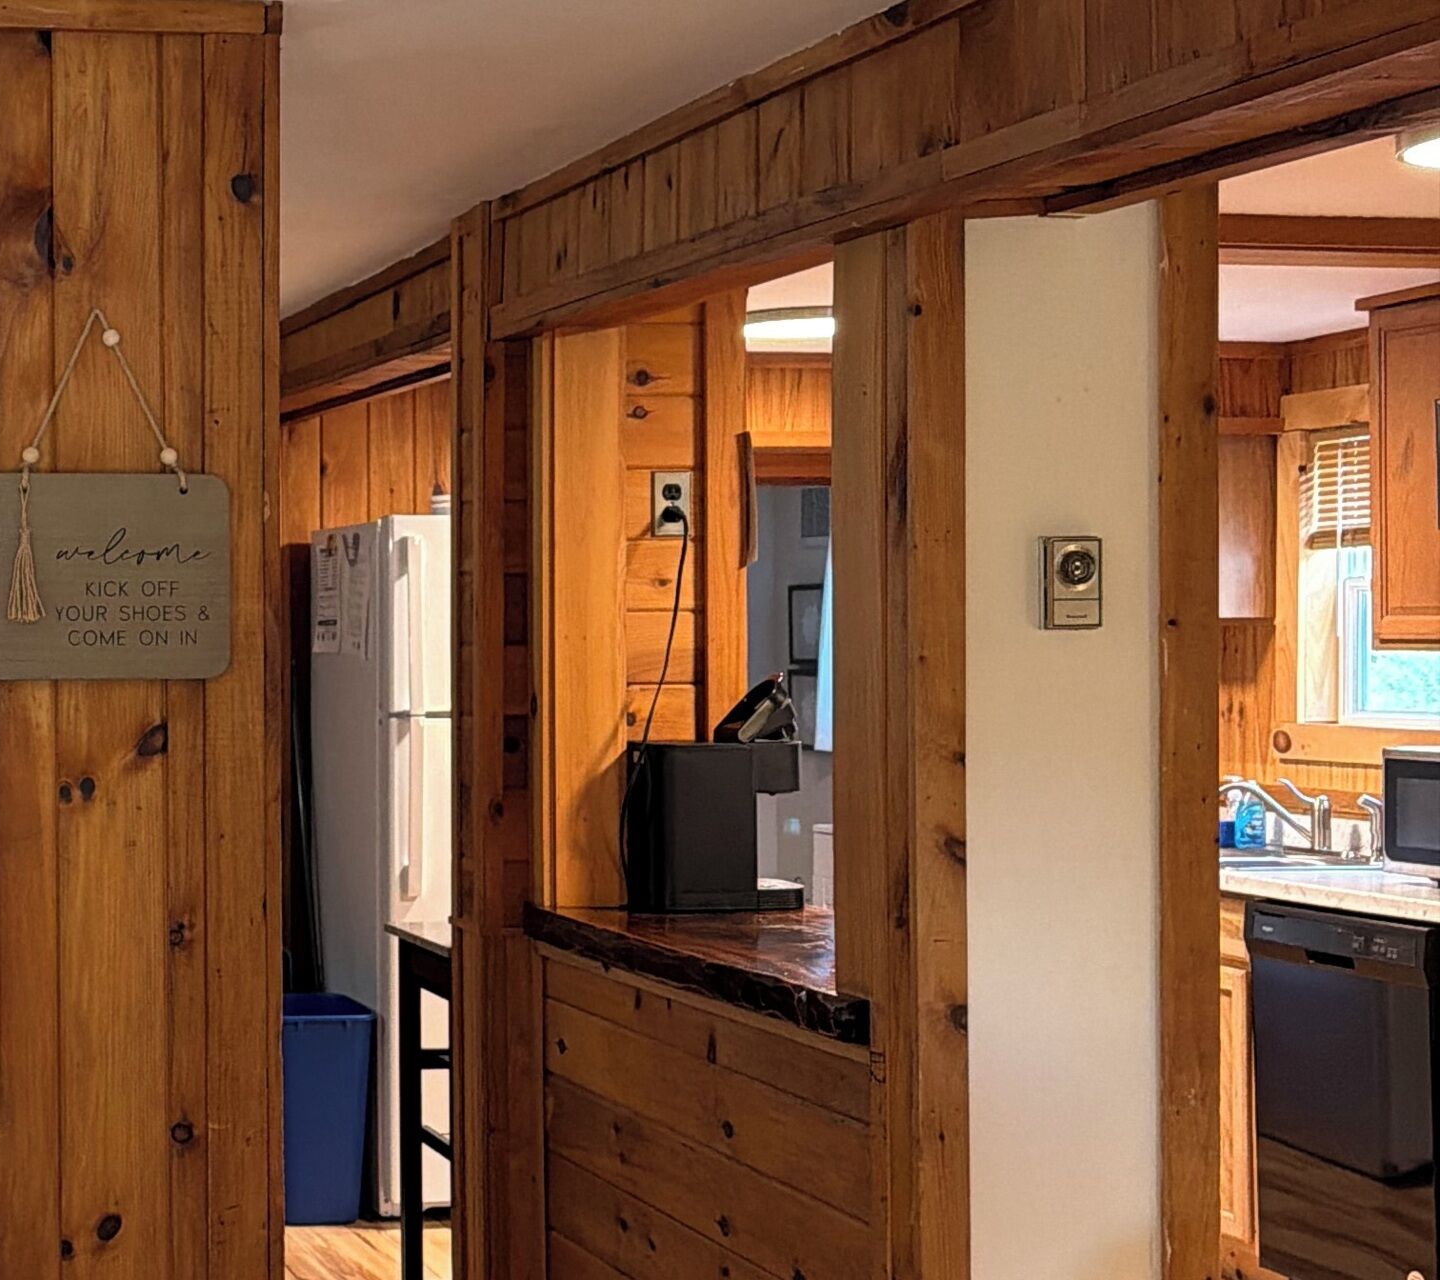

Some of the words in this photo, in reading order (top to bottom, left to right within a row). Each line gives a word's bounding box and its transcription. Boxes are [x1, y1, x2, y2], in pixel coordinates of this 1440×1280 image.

[56, 527, 211, 565] welcome
[85, 580, 128, 597] KICK
[141, 580, 179, 597] OFF
[55, 605, 107, 621] YOUR
[119, 605, 186, 621] SHOES
[198, 605, 210, 621] &
[68, 630, 127, 646] COME
[139, 630, 168, 646] ON
[179, 630, 198, 646] IN
